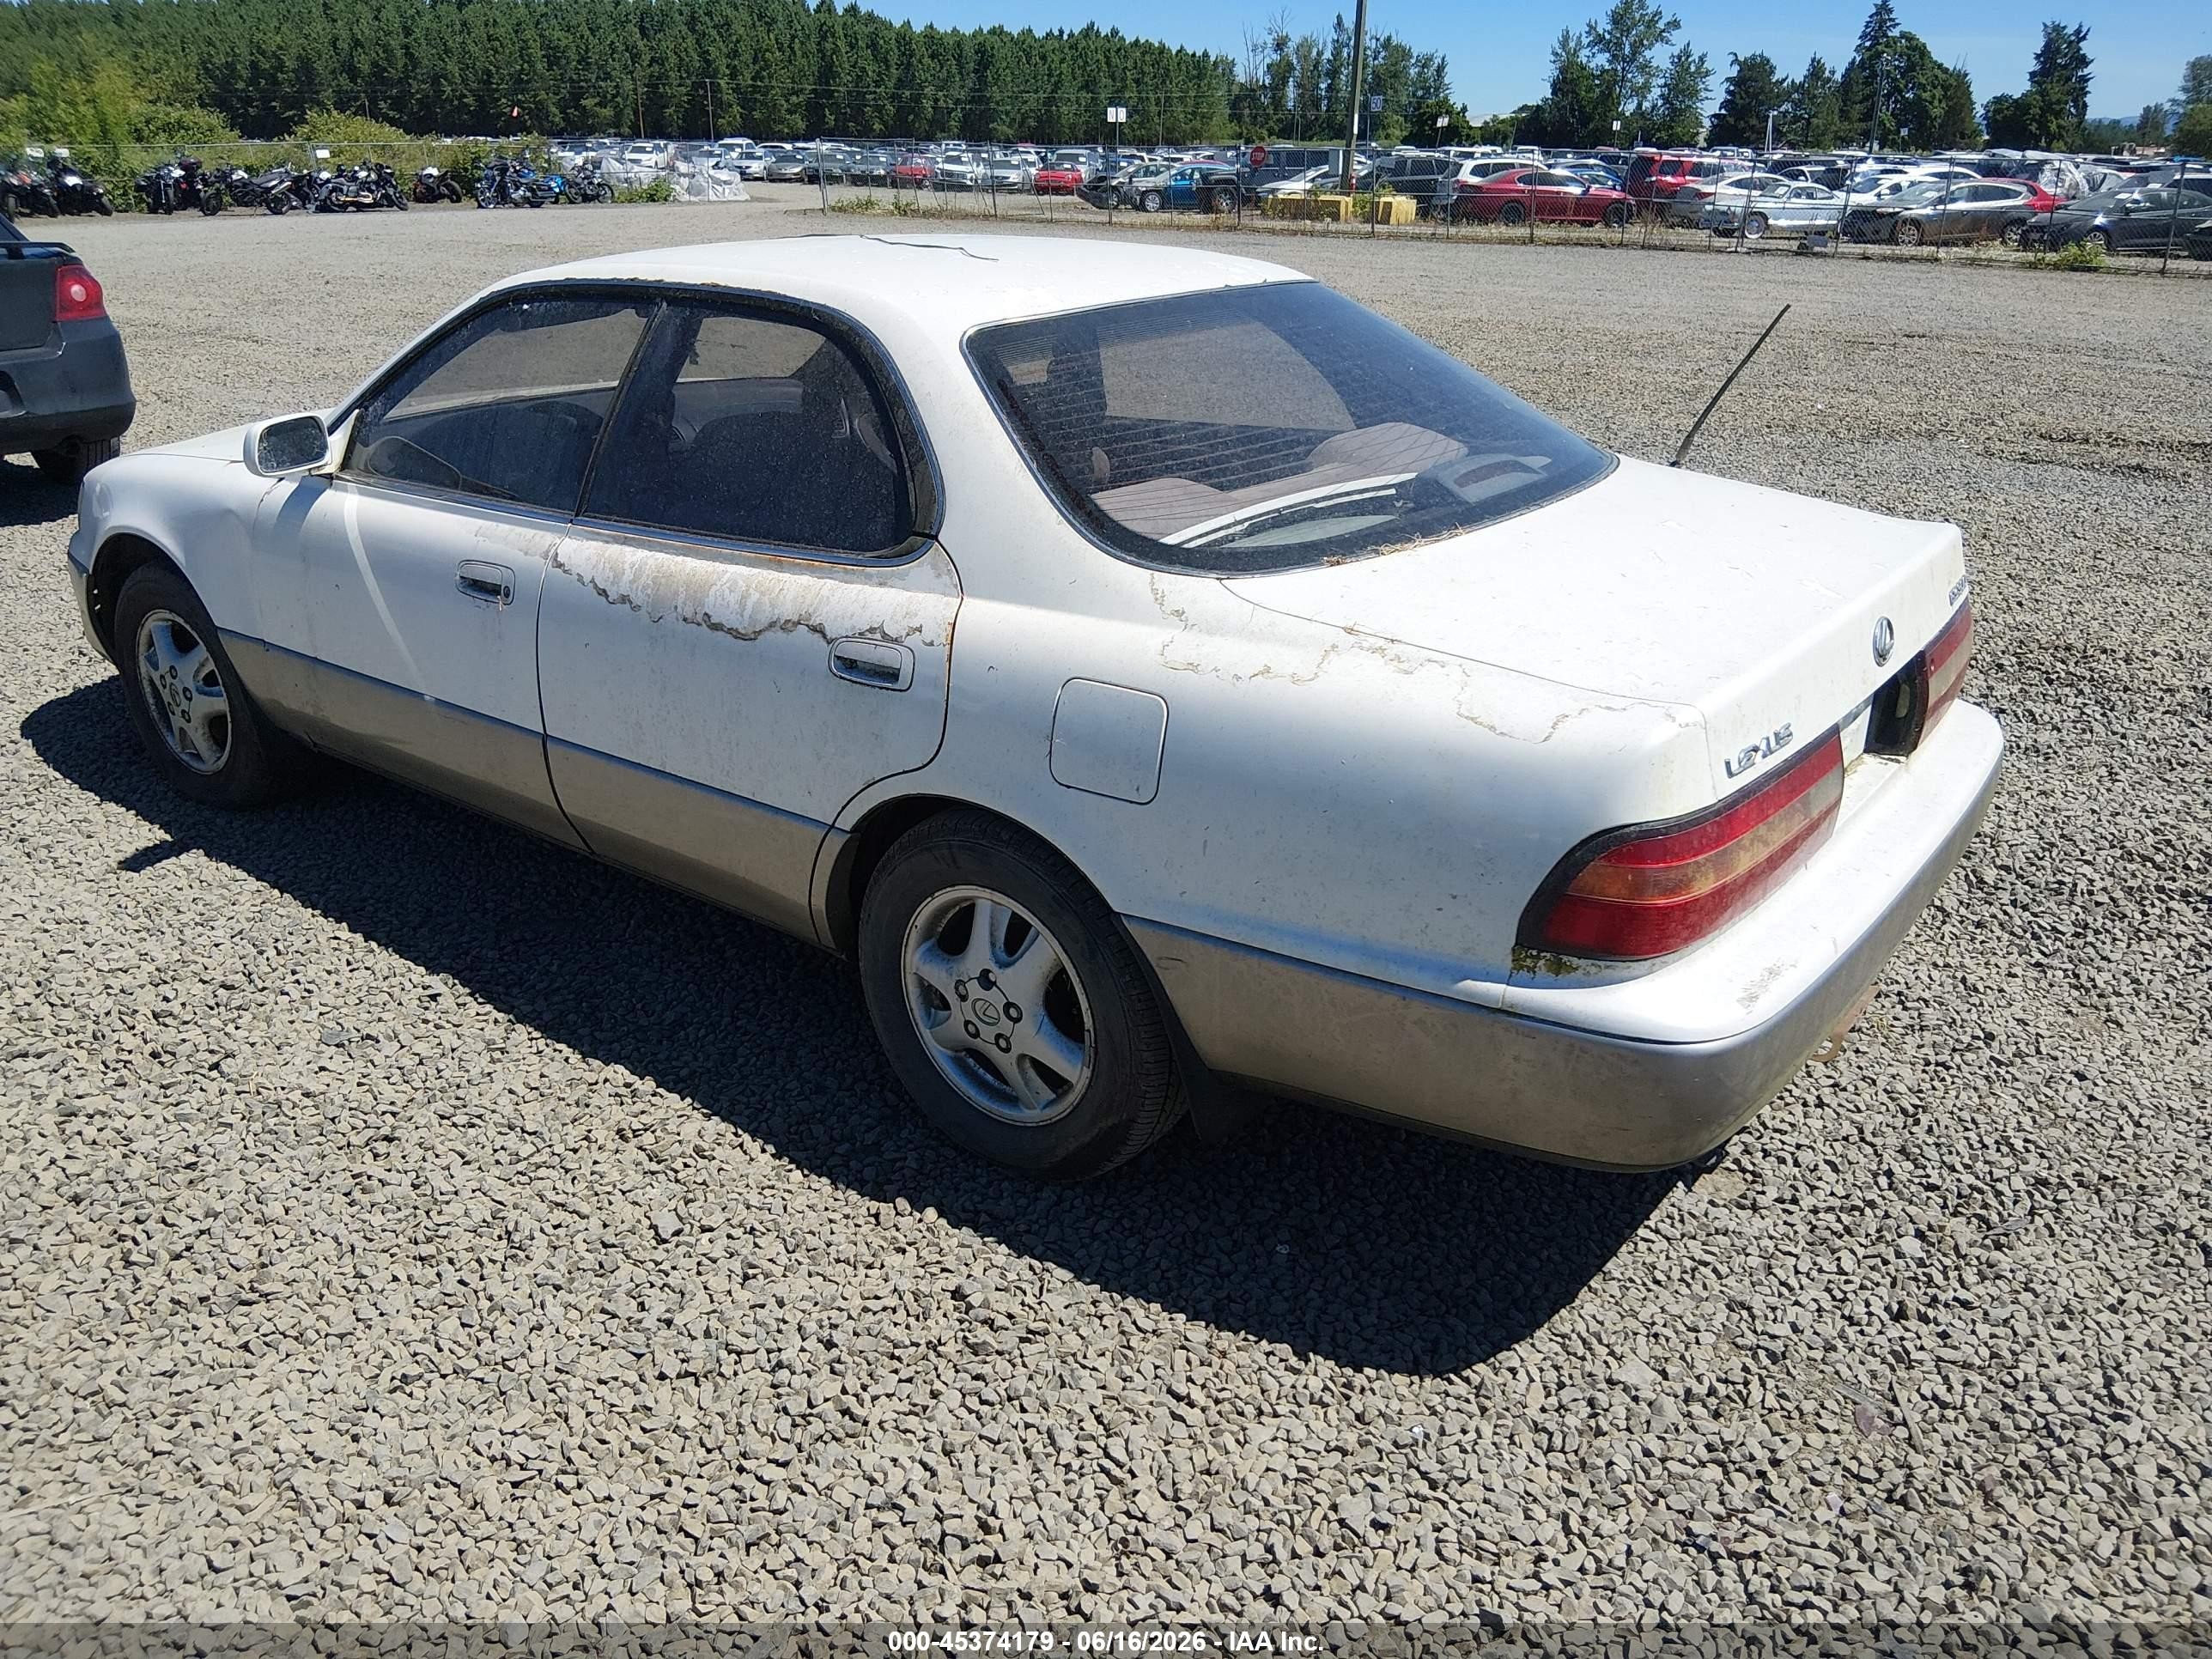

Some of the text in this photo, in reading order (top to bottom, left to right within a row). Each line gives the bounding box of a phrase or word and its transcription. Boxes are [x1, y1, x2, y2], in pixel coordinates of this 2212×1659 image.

[1371, 97, 1382, 110] 50
[1251, 152, 1265, 161] STOP
[1724, 722, 1793, 779] LEXUS
